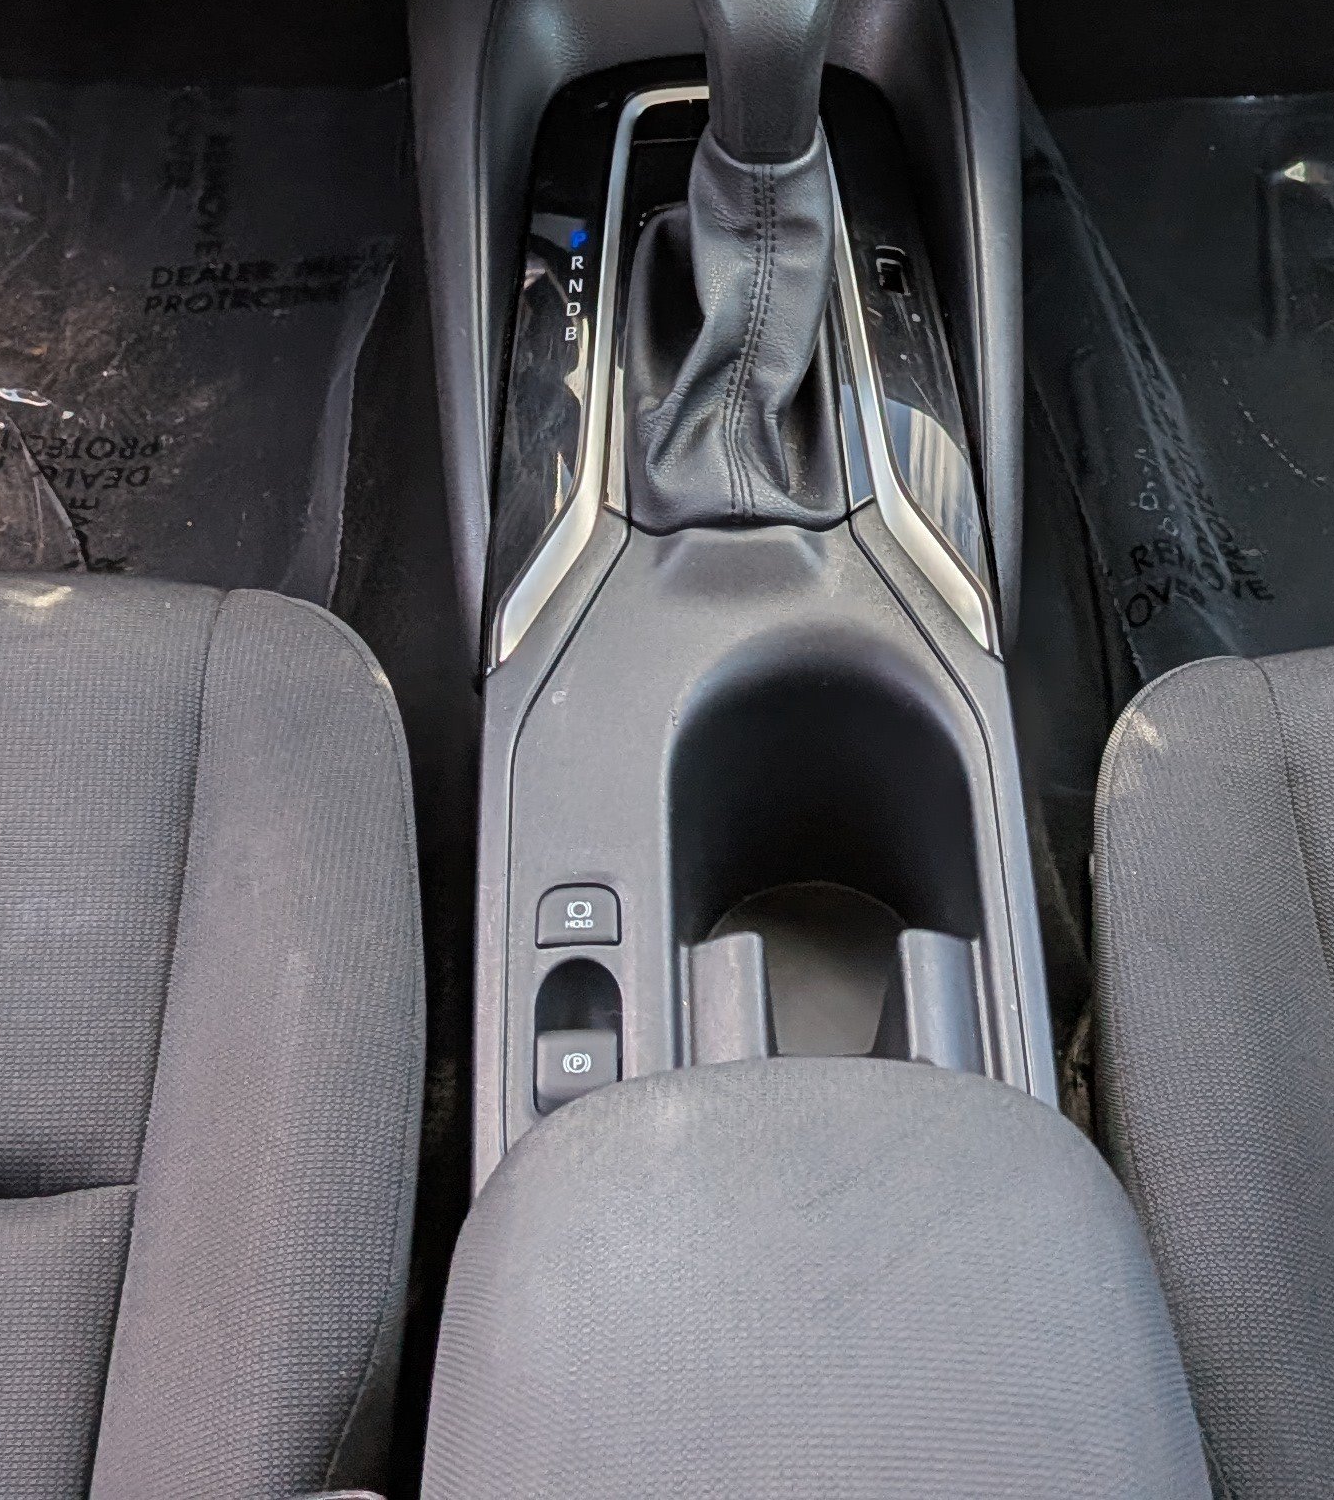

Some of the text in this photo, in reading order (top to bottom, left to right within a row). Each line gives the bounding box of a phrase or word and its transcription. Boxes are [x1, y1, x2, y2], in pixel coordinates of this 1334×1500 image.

[570, 230, 587, 248] P
[570, 255, 585, 271] R
[568, 278, 584, 294] N
[566, 300, 582, 317] D
[564, 326, 578, 342] B
[565, 920, 594, 929] HOLD
[572, 1057, 583, 1069] P
